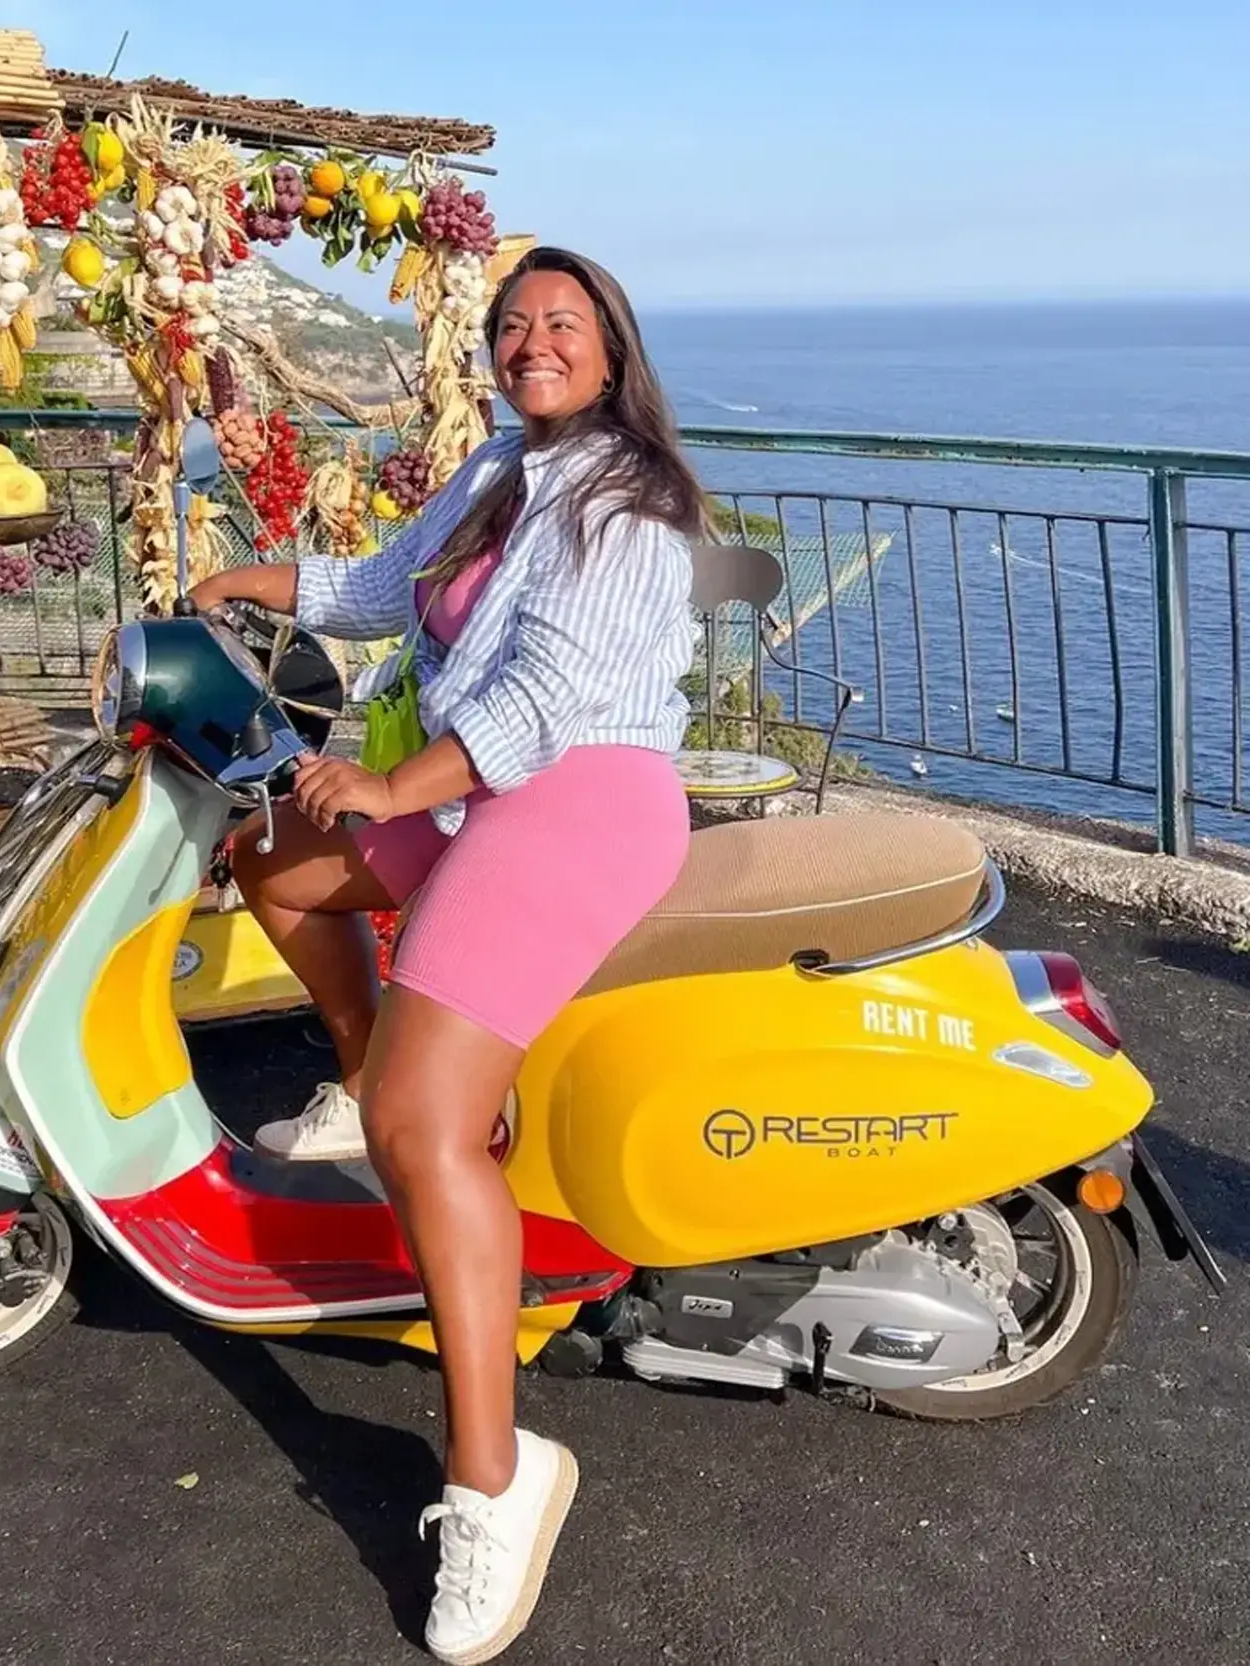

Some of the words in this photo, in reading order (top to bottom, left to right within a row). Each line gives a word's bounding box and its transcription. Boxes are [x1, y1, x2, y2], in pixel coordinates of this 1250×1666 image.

[862, 1000, 929, 1040] RENT
[938, 1014, 976, 1050] ME
[762, 1112, 959, 1144] RESTART
[827, 1146, 897, 1158] BOAT
